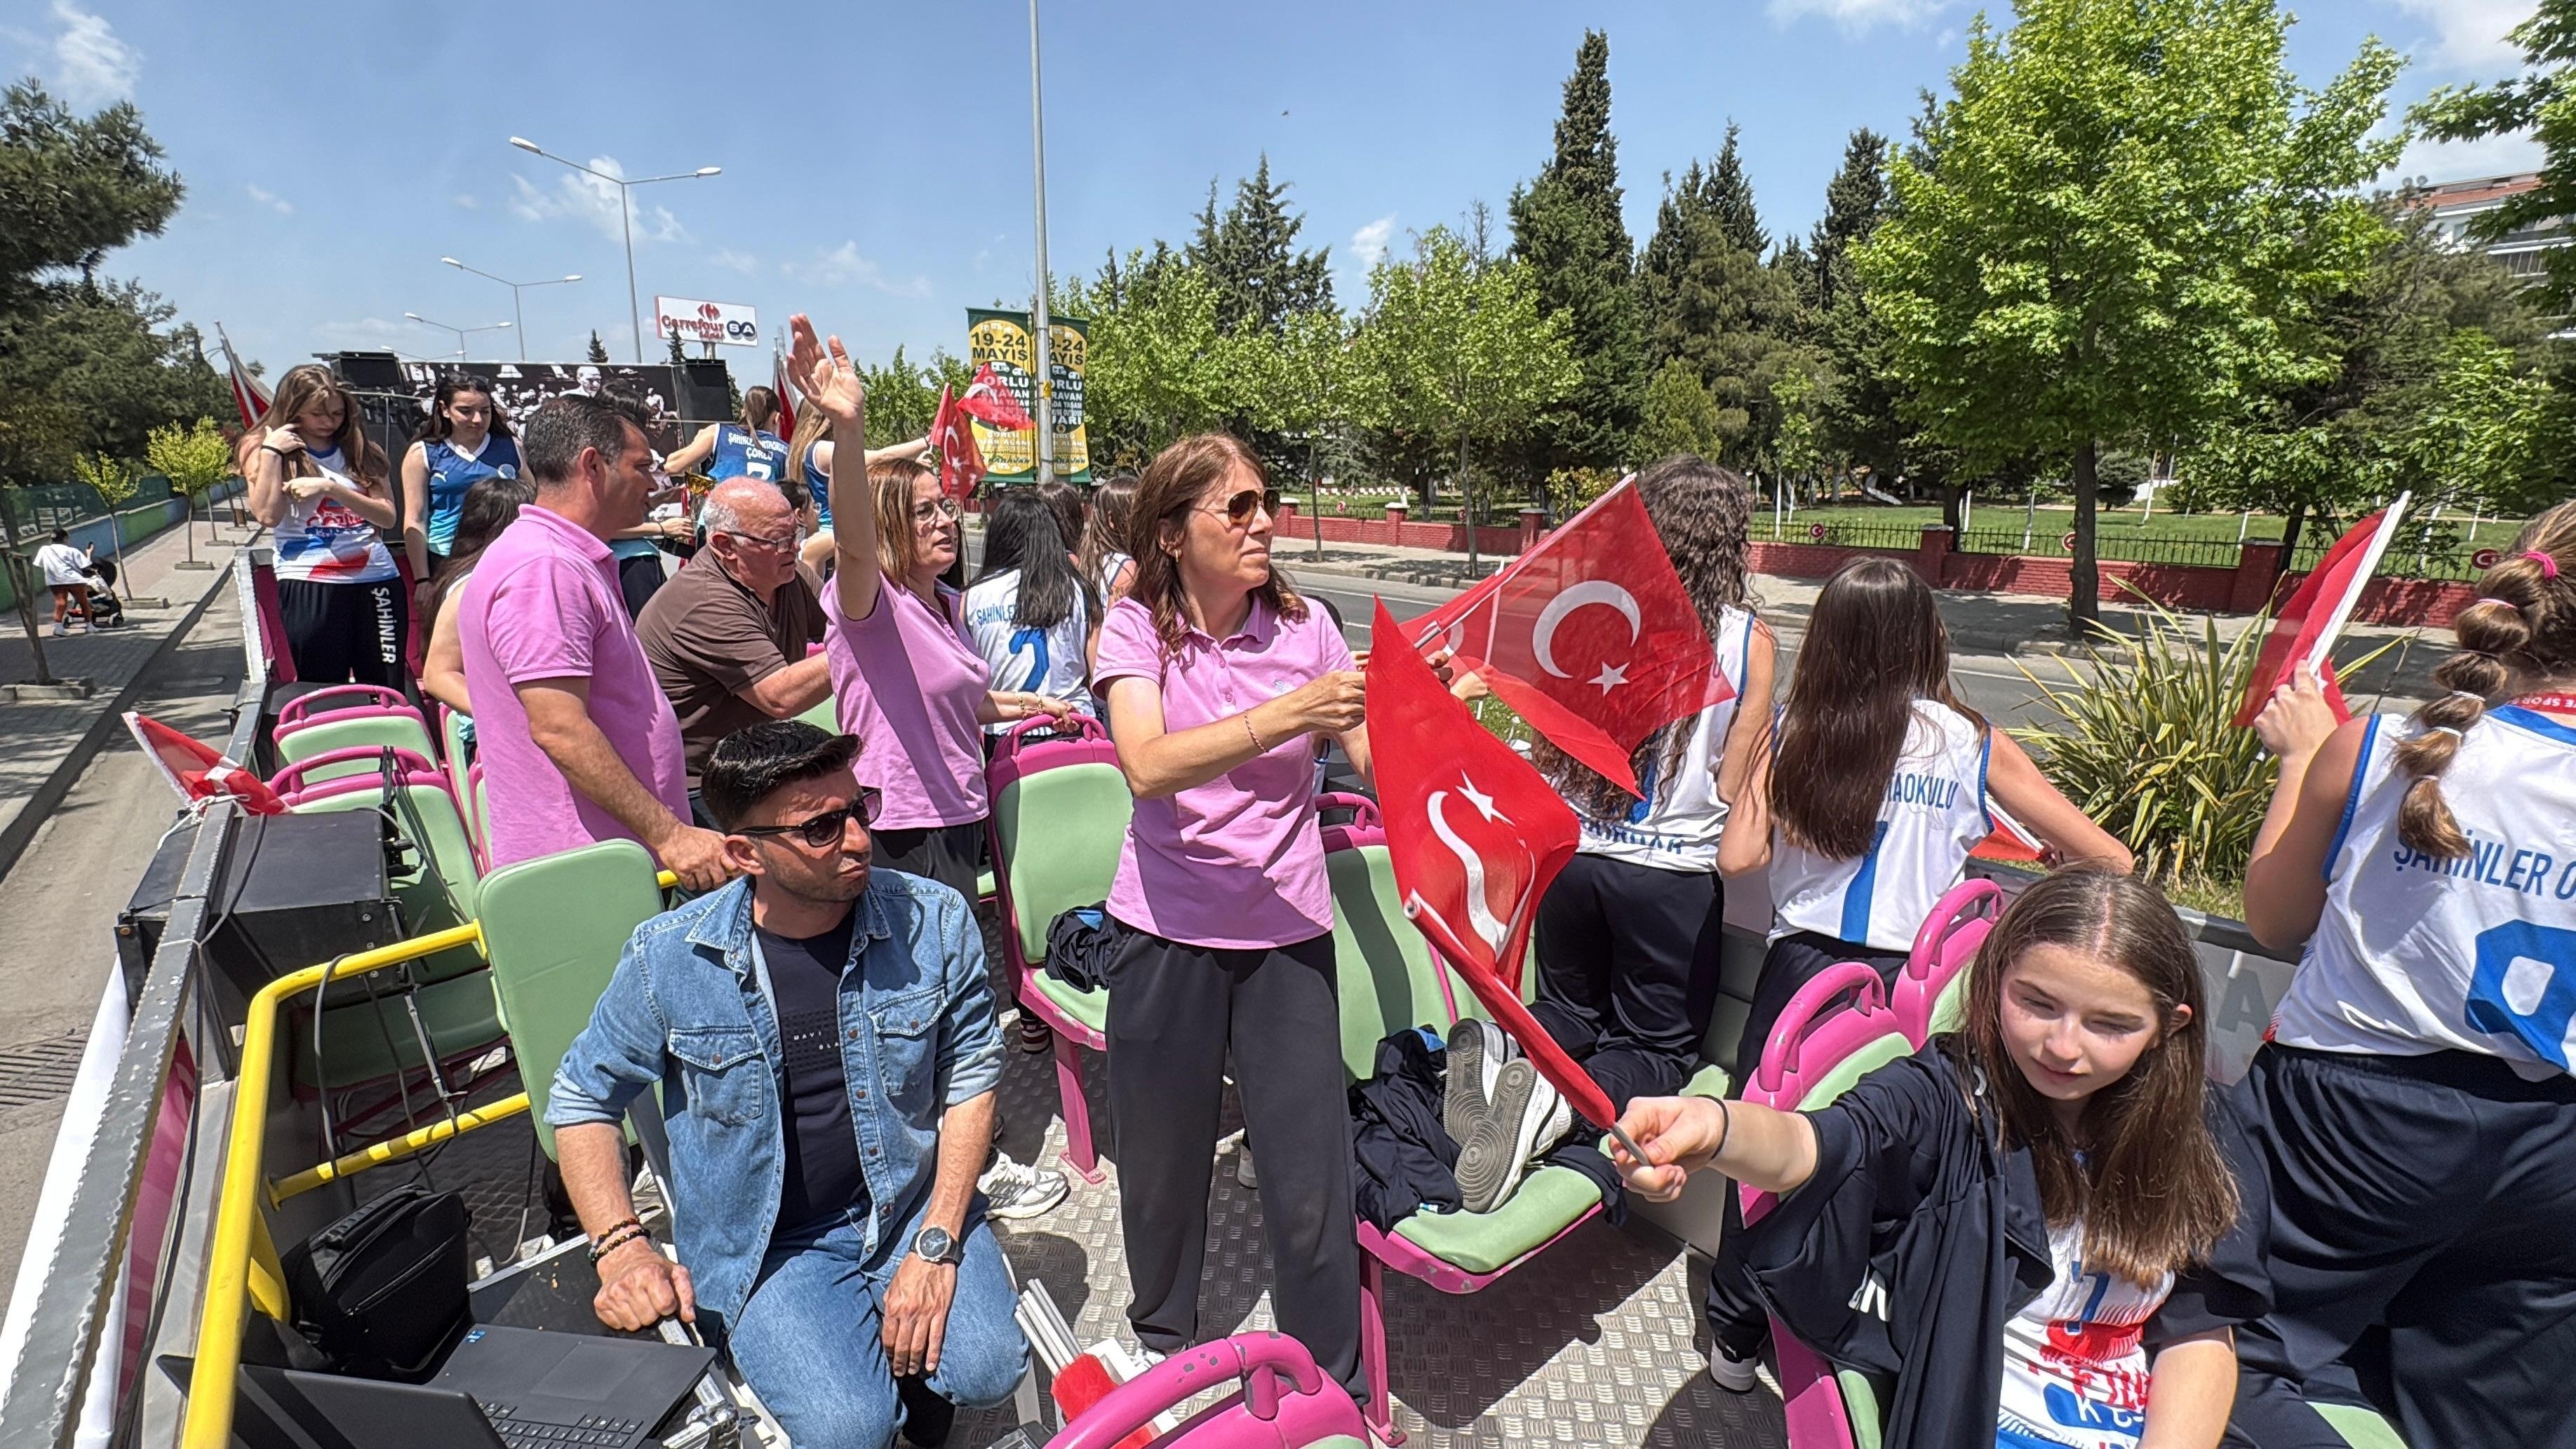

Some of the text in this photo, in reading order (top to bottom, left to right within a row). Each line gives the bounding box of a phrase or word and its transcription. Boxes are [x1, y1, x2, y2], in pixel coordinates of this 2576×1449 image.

[662, 315, 725, 333] Carrefour
[727, 322, 756, 336] SA
[972, 333, 1027, 348] 19-24
[1049, 339, 1084, 353] 9-24
[972, 346, 1028, 362] MAYIS
[1051, 352, 1084, 365] AYIS
[977, 602, 1018, 629] ŞAHİNLE
[370, 586, 398, 664] ŞAHİNLER
